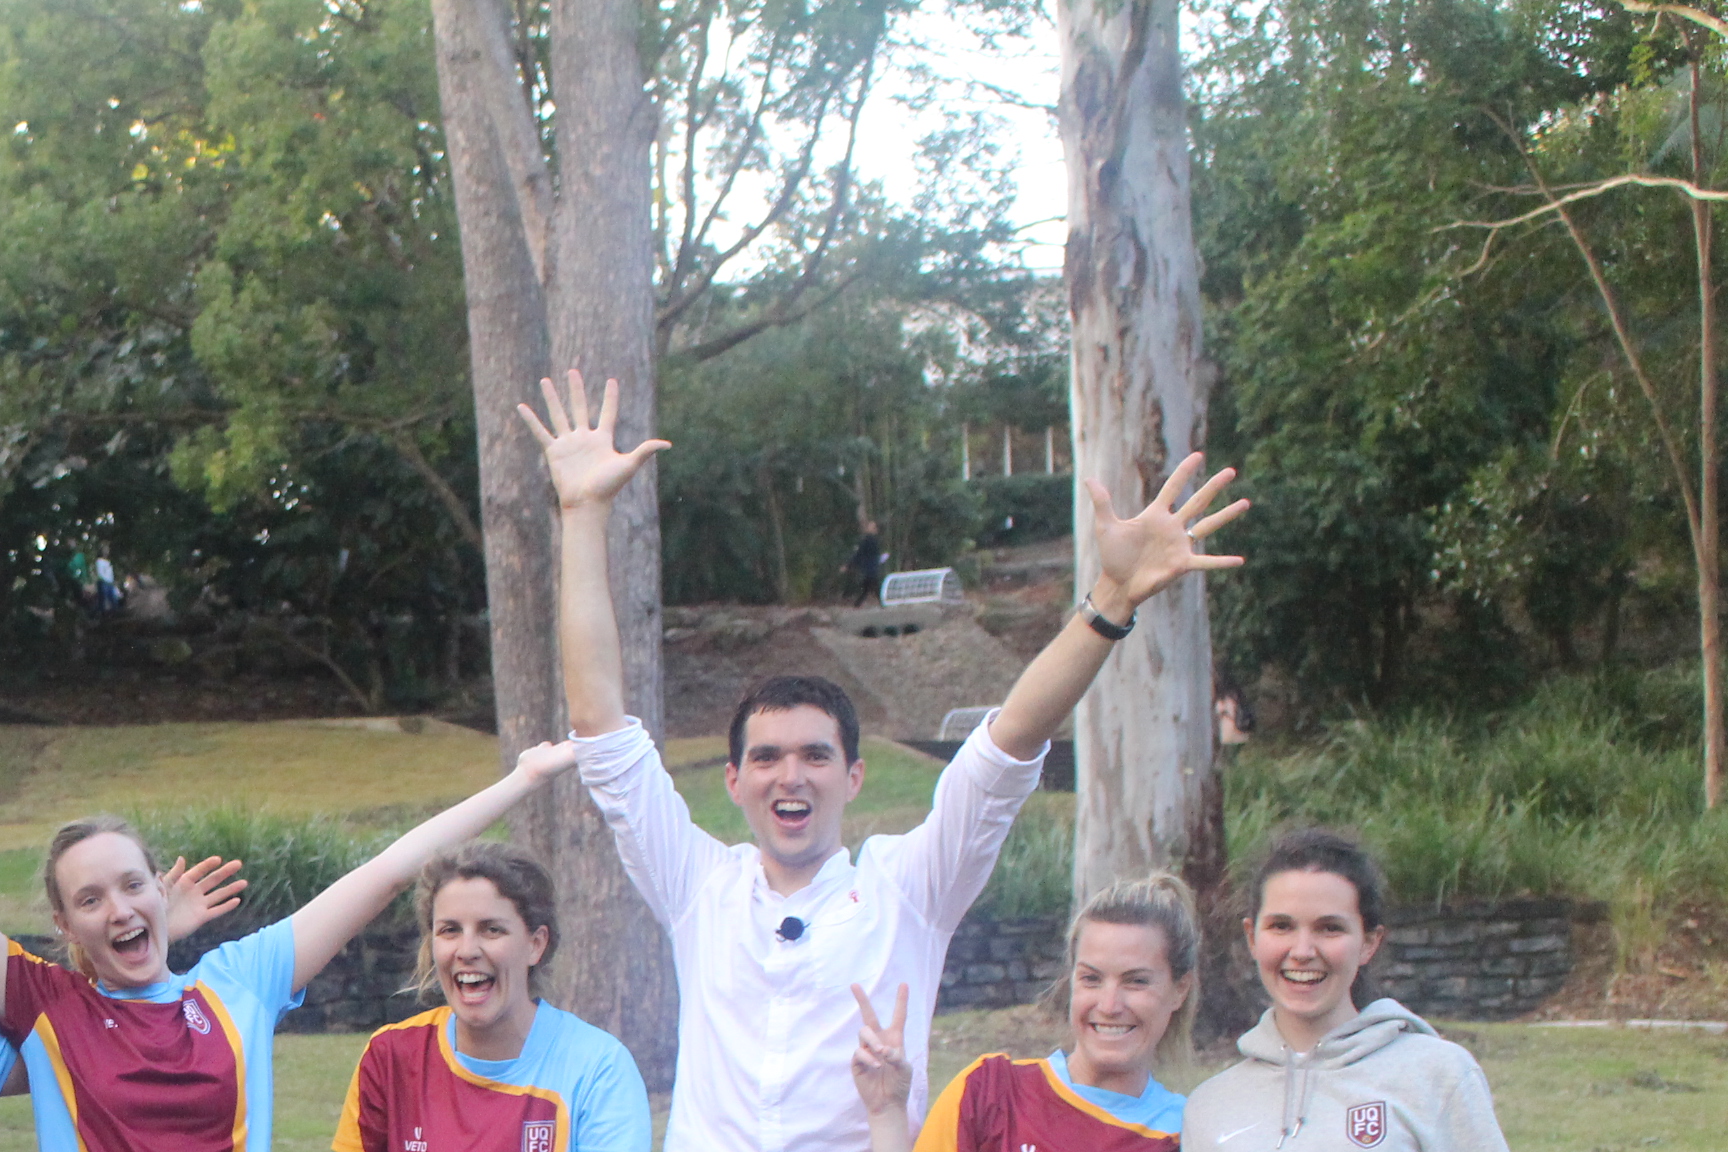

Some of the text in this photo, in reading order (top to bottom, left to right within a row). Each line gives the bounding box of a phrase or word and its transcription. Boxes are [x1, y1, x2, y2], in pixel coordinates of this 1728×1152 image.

[1354, 1107, 1379, 1123] UQ
[529, 1127, 549, 1141] UQ
[1354, 1121, 1379, 1136] FC
[404, 1140, 428, 1152] VETO
